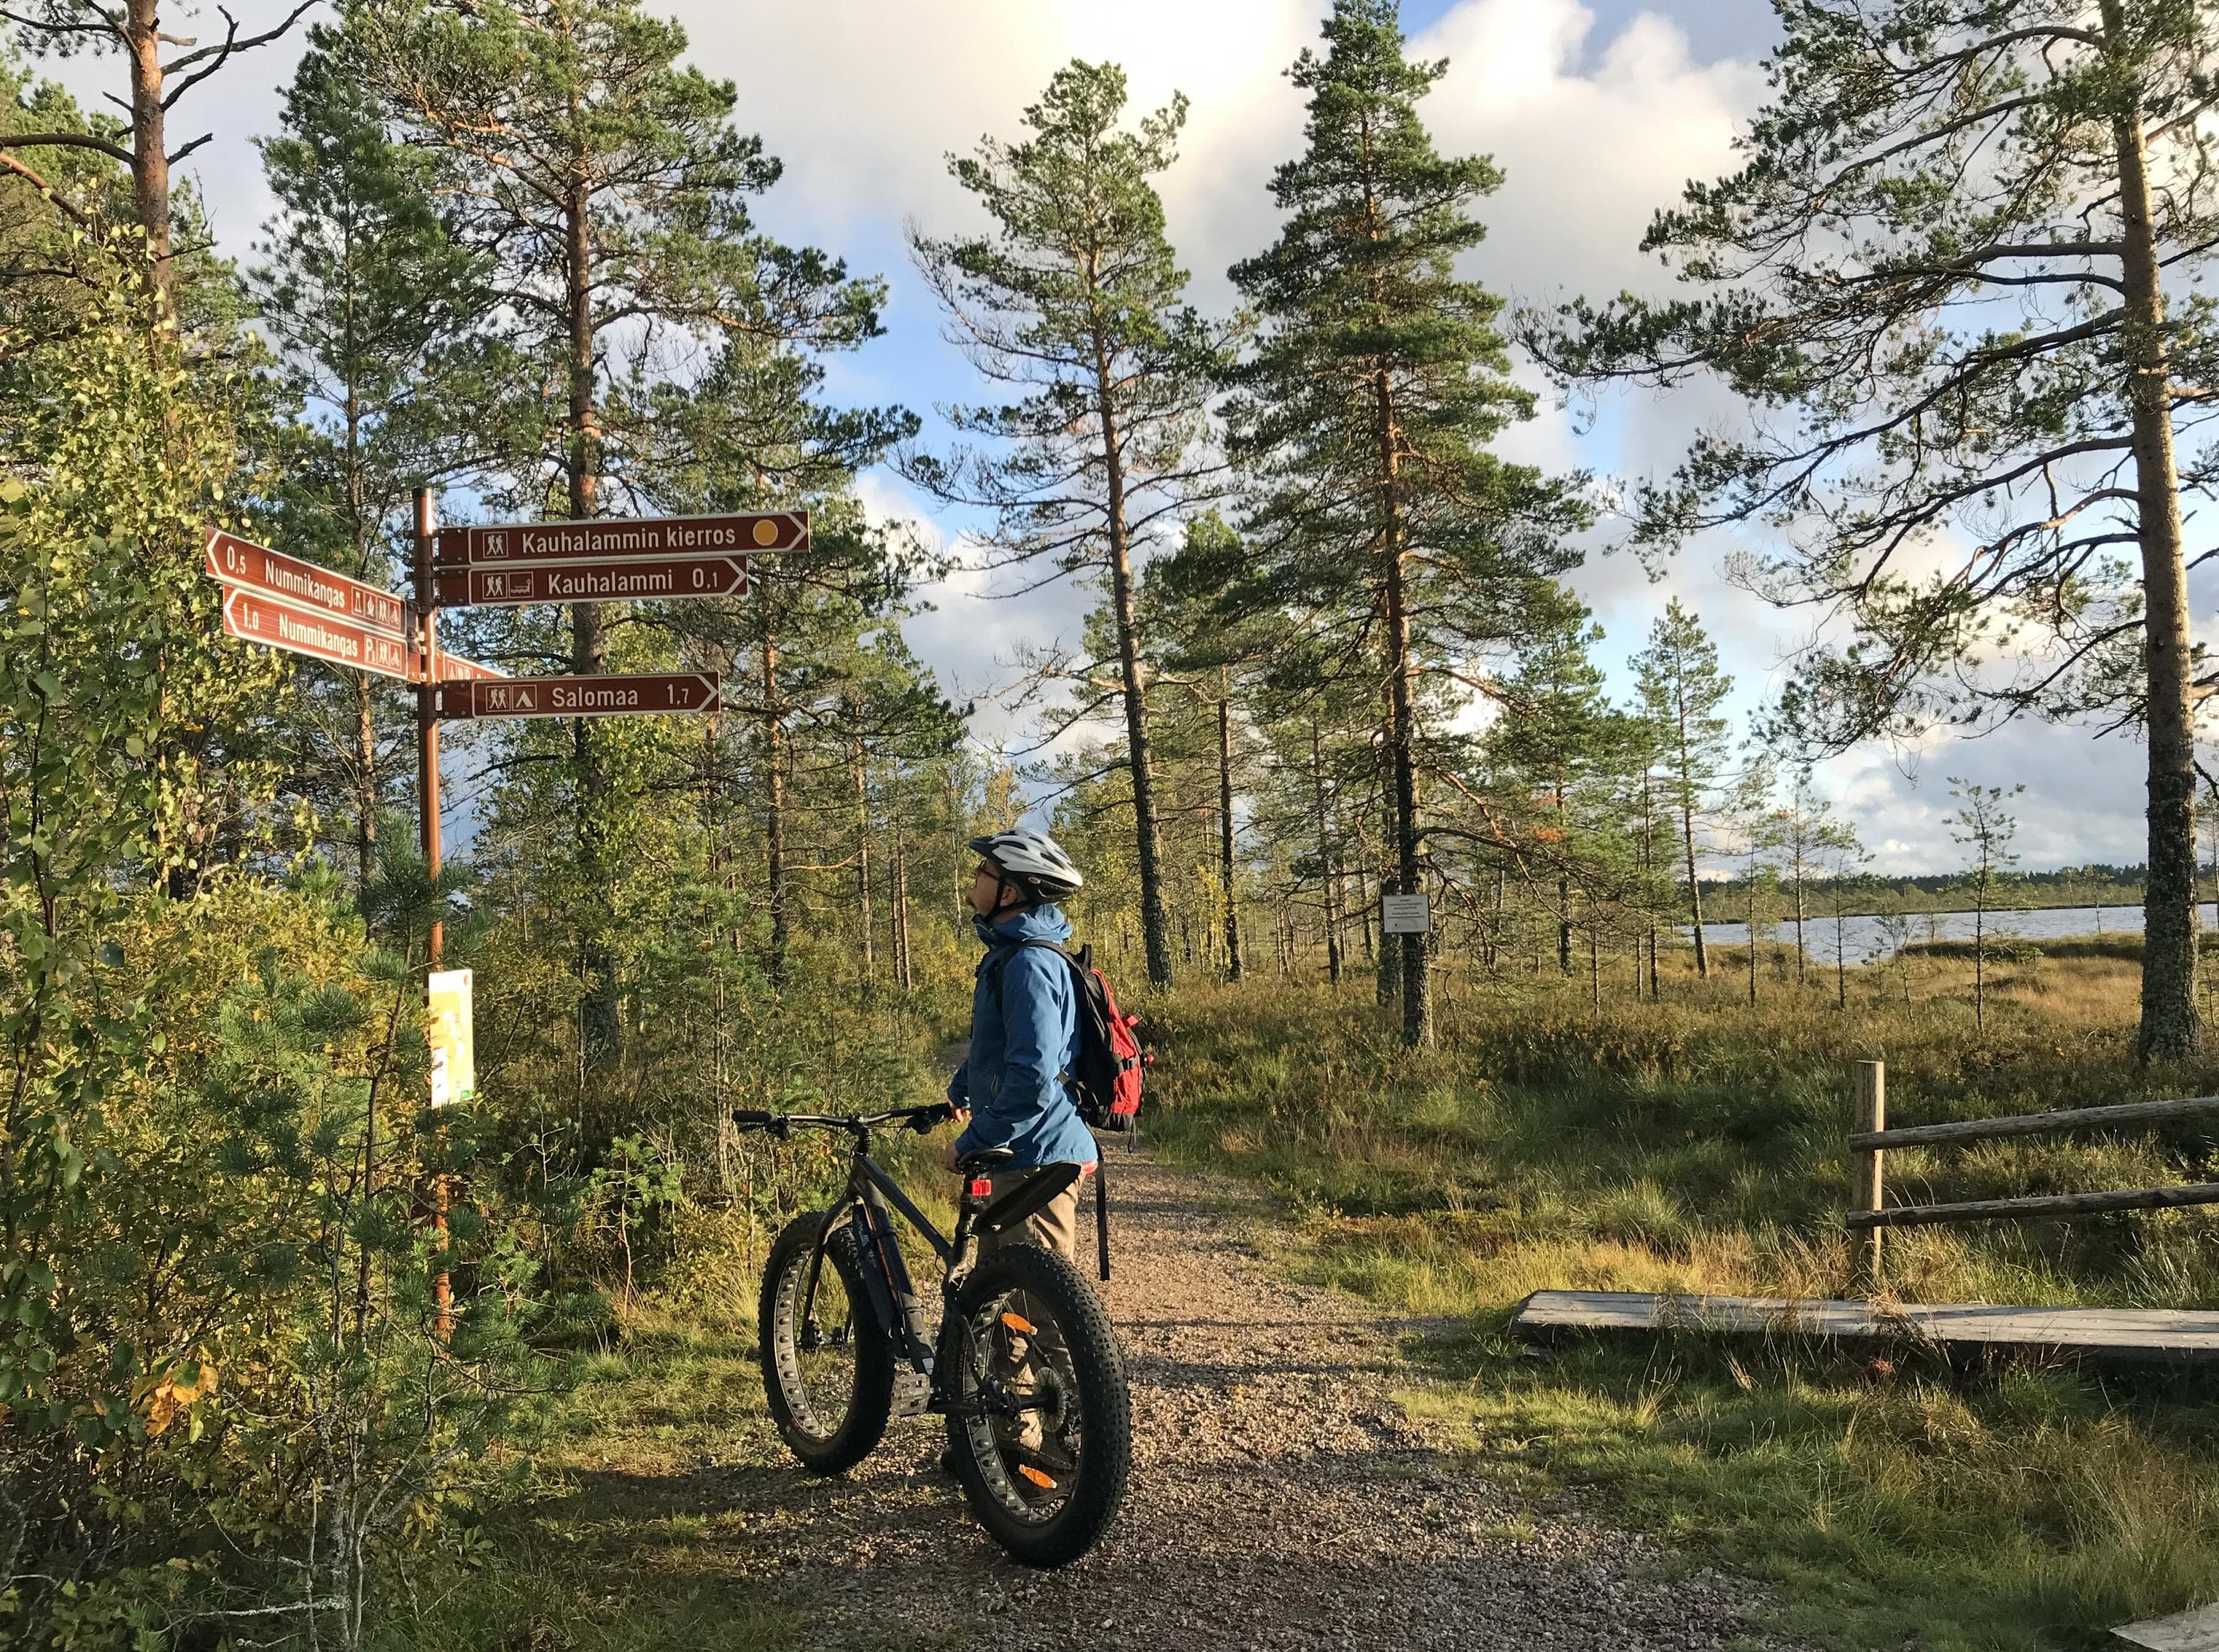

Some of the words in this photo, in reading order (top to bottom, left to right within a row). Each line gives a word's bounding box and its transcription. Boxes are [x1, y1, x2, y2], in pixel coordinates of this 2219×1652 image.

[522, 528, 659, 553] Kauhalammin
[666, 526, 736, 546] kierros
[226, 545, 246, 575] 0,5
[265, 558, 345, 609] Nummikangas
[548, 569, 673, 595] Kauhalammi
[692, 568, 717, 589] 0,1
[243, 602, 259, 630] 1,0
[279, 613, 358, 657] Nummikangas
[552, 686, 638, 707] Salomaa
[667, 683, 689, 705] 1,7
